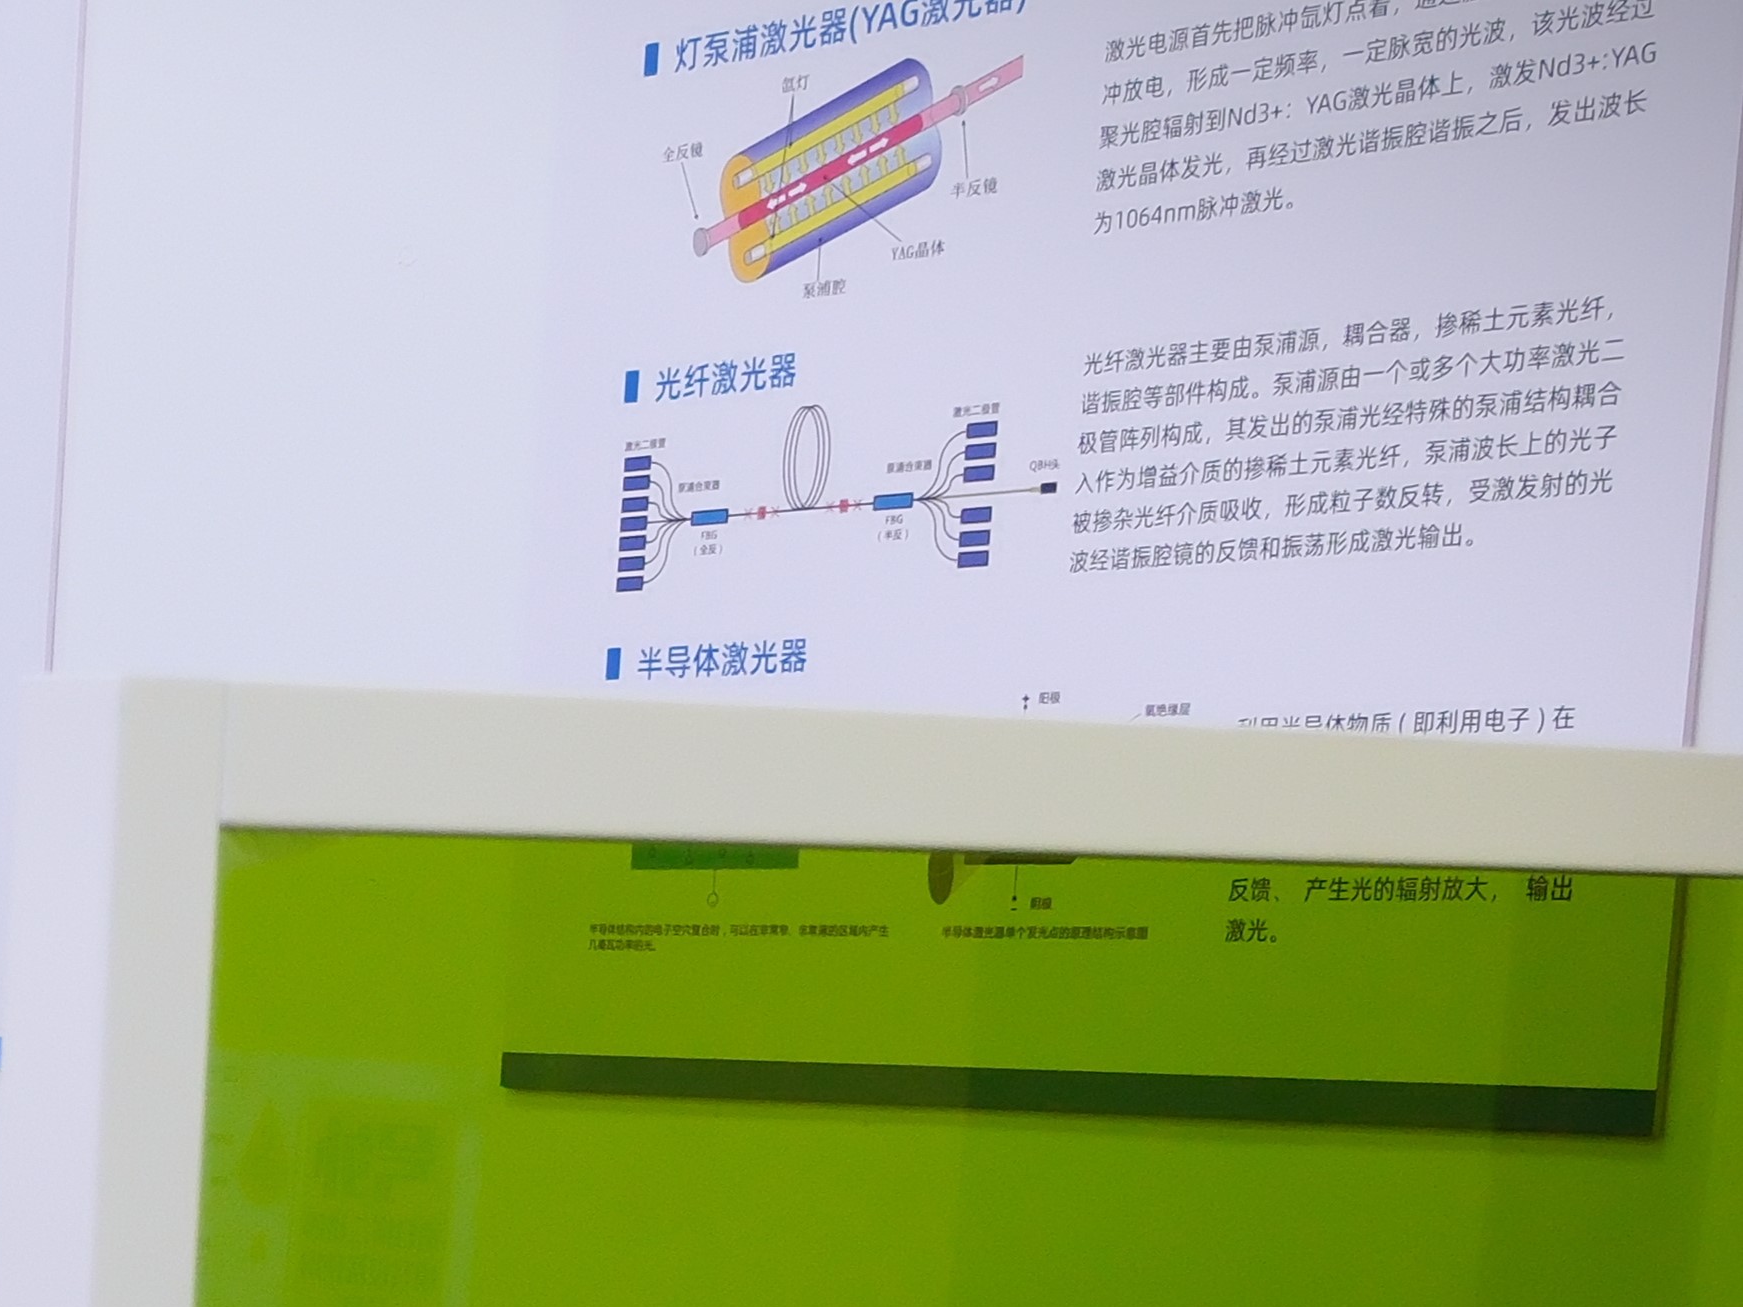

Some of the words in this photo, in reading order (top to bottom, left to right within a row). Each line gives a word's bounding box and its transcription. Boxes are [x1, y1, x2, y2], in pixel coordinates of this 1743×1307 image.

[1104, 0, 1476, 64] 激光电源首先把脉冲氙灯点着，
[662, 141, 704, 164] 全反镜
[1095, 89, 1648, 193] 激光晶体发光，再经过激光谐振腔谐振之后，发出波长
[950, 178, 998, 199] 半反镜
[1092, 187, 1296, 236] 为1064nm脉冲激光。
[890, 239, 946, 261] YAG晶体
[802, 278, 847, 300] 泵浦腔
[655, 352, 797, 403] 光纤激光器
[1080, 337, 1626, 416] 谐振腔等部件构成。泵浦源由一个或多个大功率激光二
[1077, 380, 1622, 456] 极管阵列构成，其发出的泵浦光经特殊的泵浦结构耦合
[1074, 424, 1619, 496] 入作为增益介质的掺稀土元素光纤，泵浦波长上的光子
[1071, 468, 1614, 535] 被掺杂光纤介质吸收，形成粒子数反转，受激发射的光
[1069, 521, 1476, 574] 波经谐振腔镜的反馈和振荡形成激光输出。
[637, 638, 808, 681] 半导体激光器
[1224, 918, 1278, 944] 激光。
